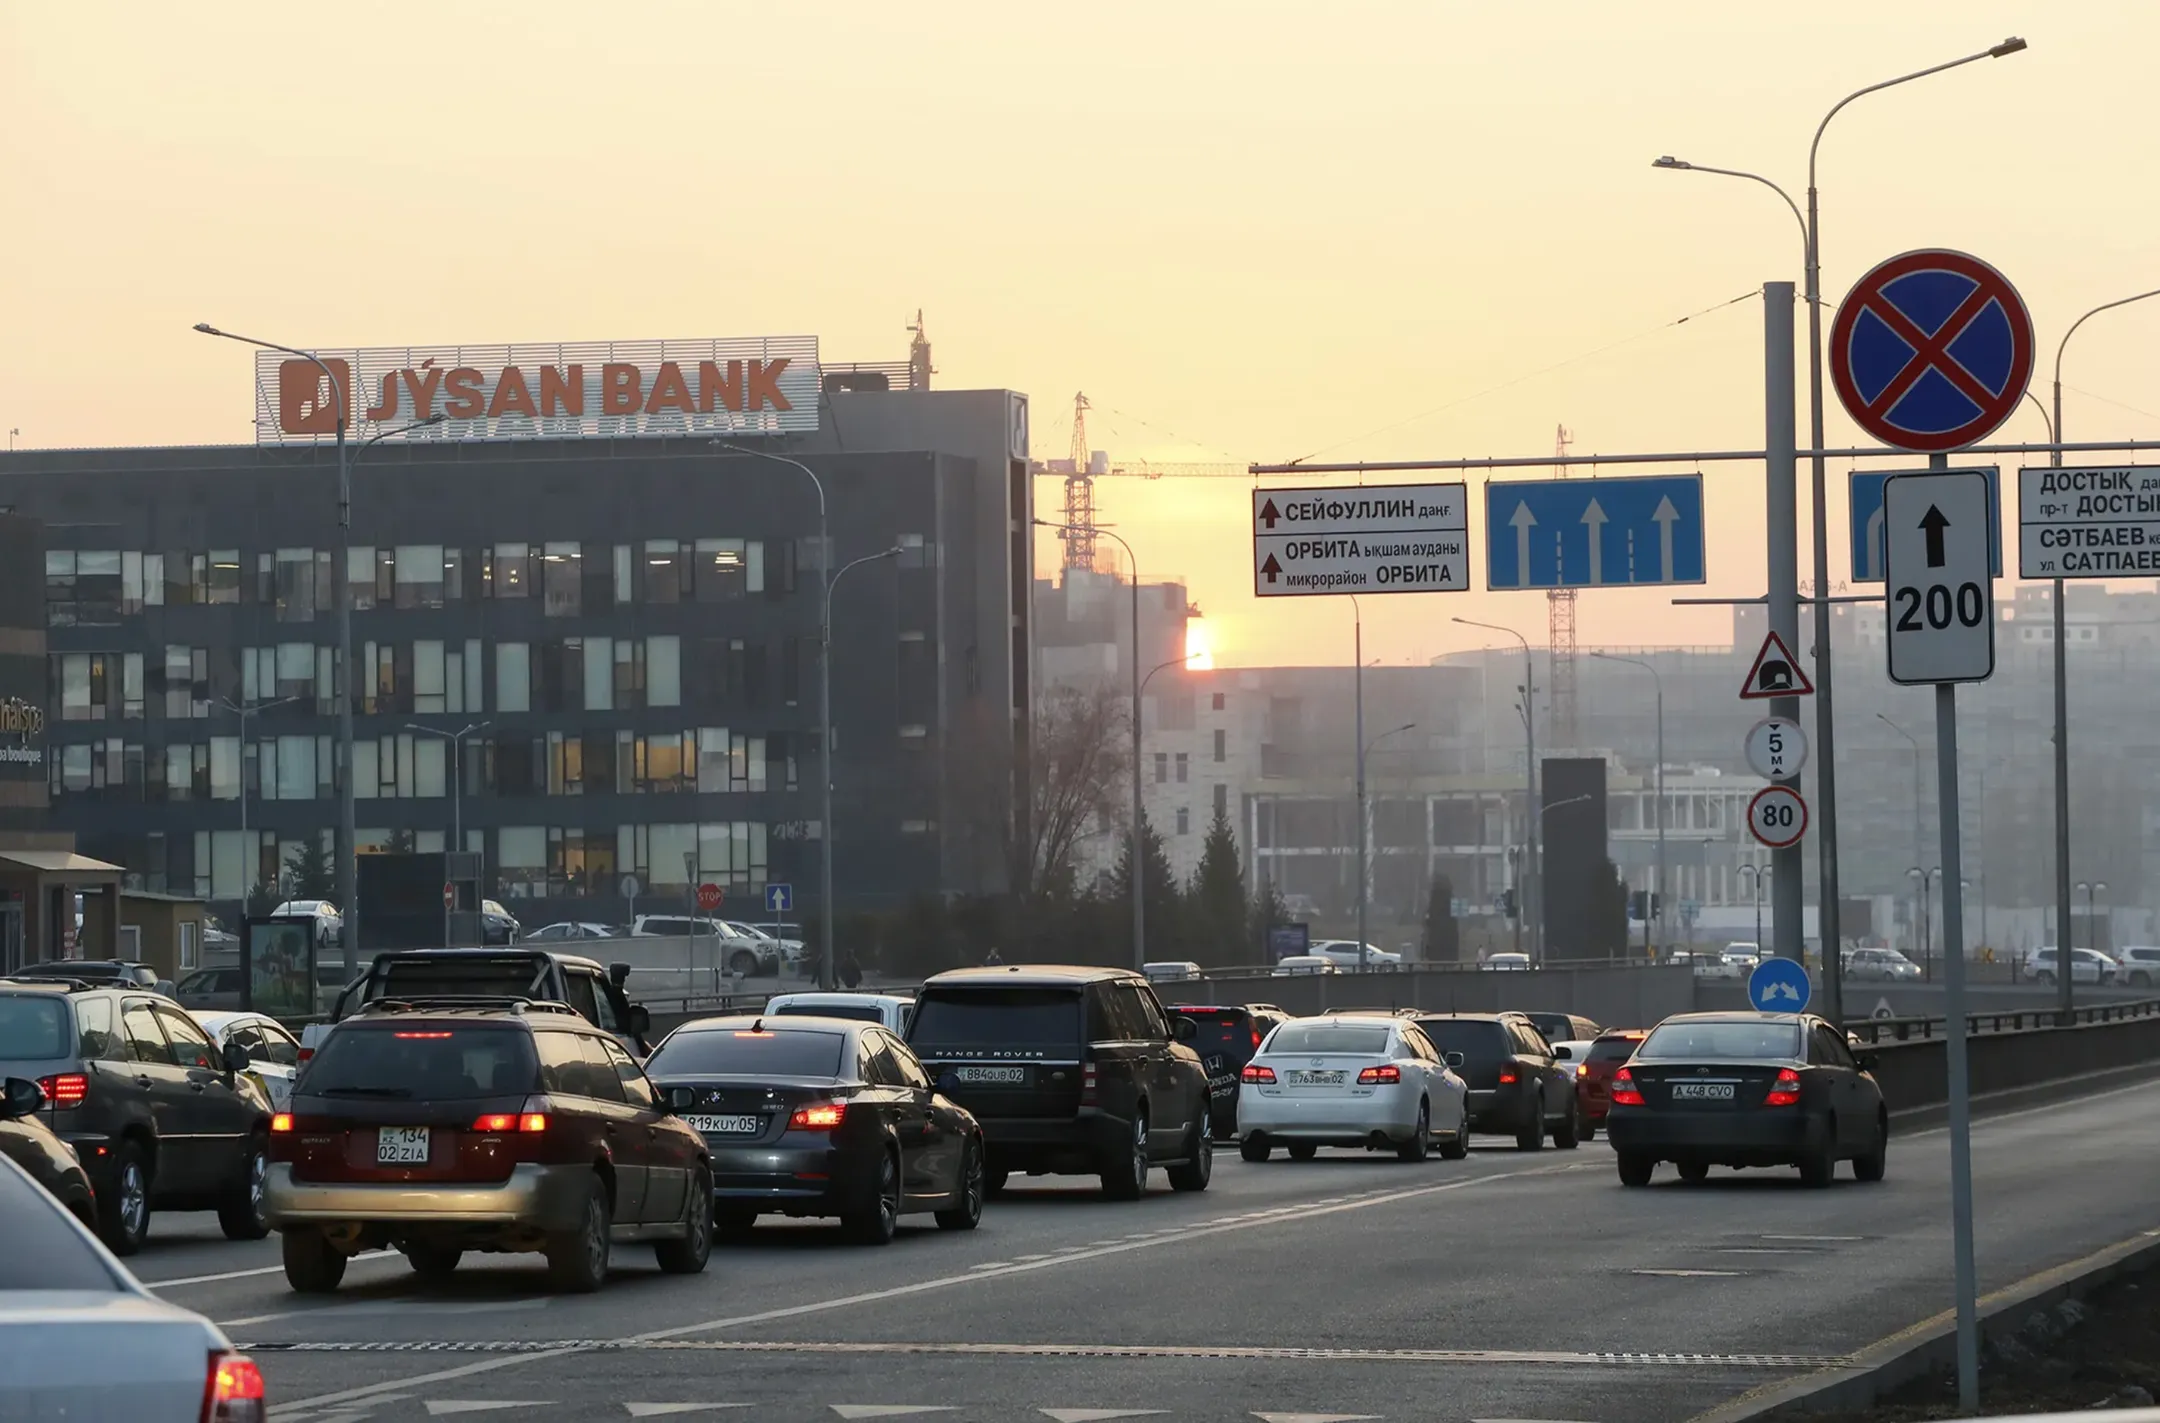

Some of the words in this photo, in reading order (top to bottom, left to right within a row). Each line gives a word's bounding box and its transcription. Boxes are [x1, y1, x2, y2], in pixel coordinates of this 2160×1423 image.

[366, 357, 583, 421] JÝSAN
[602, 358, 793, 415] BANK
[2040, 472, 2133, 495] ДОСТЫҚ
[2140, 478, 2160, 491] да
[1285, 497, 1414, 521] СЕЙФУЛЛИН
[2040, 503, 2068, 517] пр-т
[2040, 528, 2145, 548] СӘТБАЕВ
[1286, 541, 1360, 559] ОРБИТА
[1365, 544, 1411, 559] ықшам
[1413, 542, 1460, 557] ауданы
[2040, 561, 2055, 571] ул
[1286, 569, 1367, 589] микрорайон
[1376, 565, 1452, 584] ОРБИТА
[1895, 582, 1983, 632] 200
[1769, 733, 1783, 753] 5
[1763, 805, 1793, 827] 80
[698, 891, 721, 902] STOP
[1675, 1087, 1684, 1097] A
[739, 1117, 755, 1131] 05
[399, 1128, 426, 1144] 134
[379, 1146, 396, 1160] 02
[400, 1148, 424, 1160] ZIA
